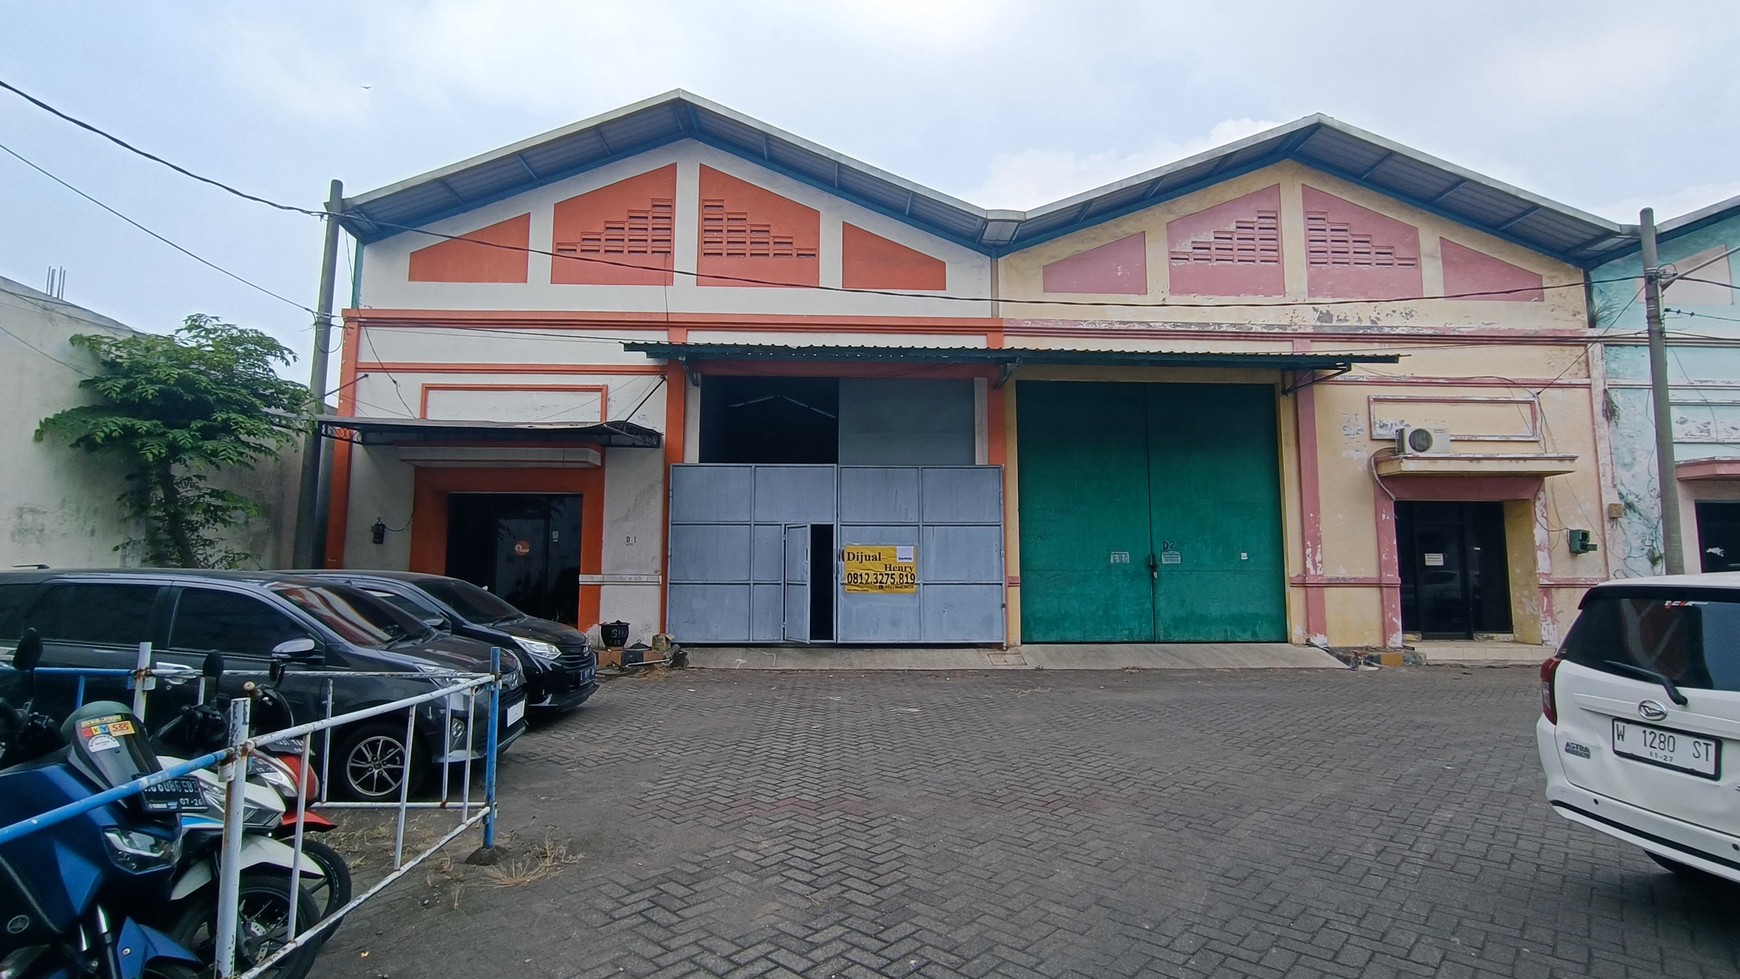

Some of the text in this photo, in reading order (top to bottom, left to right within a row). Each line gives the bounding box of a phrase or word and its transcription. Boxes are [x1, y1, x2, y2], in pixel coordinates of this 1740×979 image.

[1162, 541, 1175, 550] D2
[847, 552, 881, 563] Dijual
[884, 563, 915, 573] Henry
[847, 573, 916, 585] 0812.3275.819
[1616, 724, 1711, 761] W 1280 ST
[1649, 750, 1674, 762] 11-27
